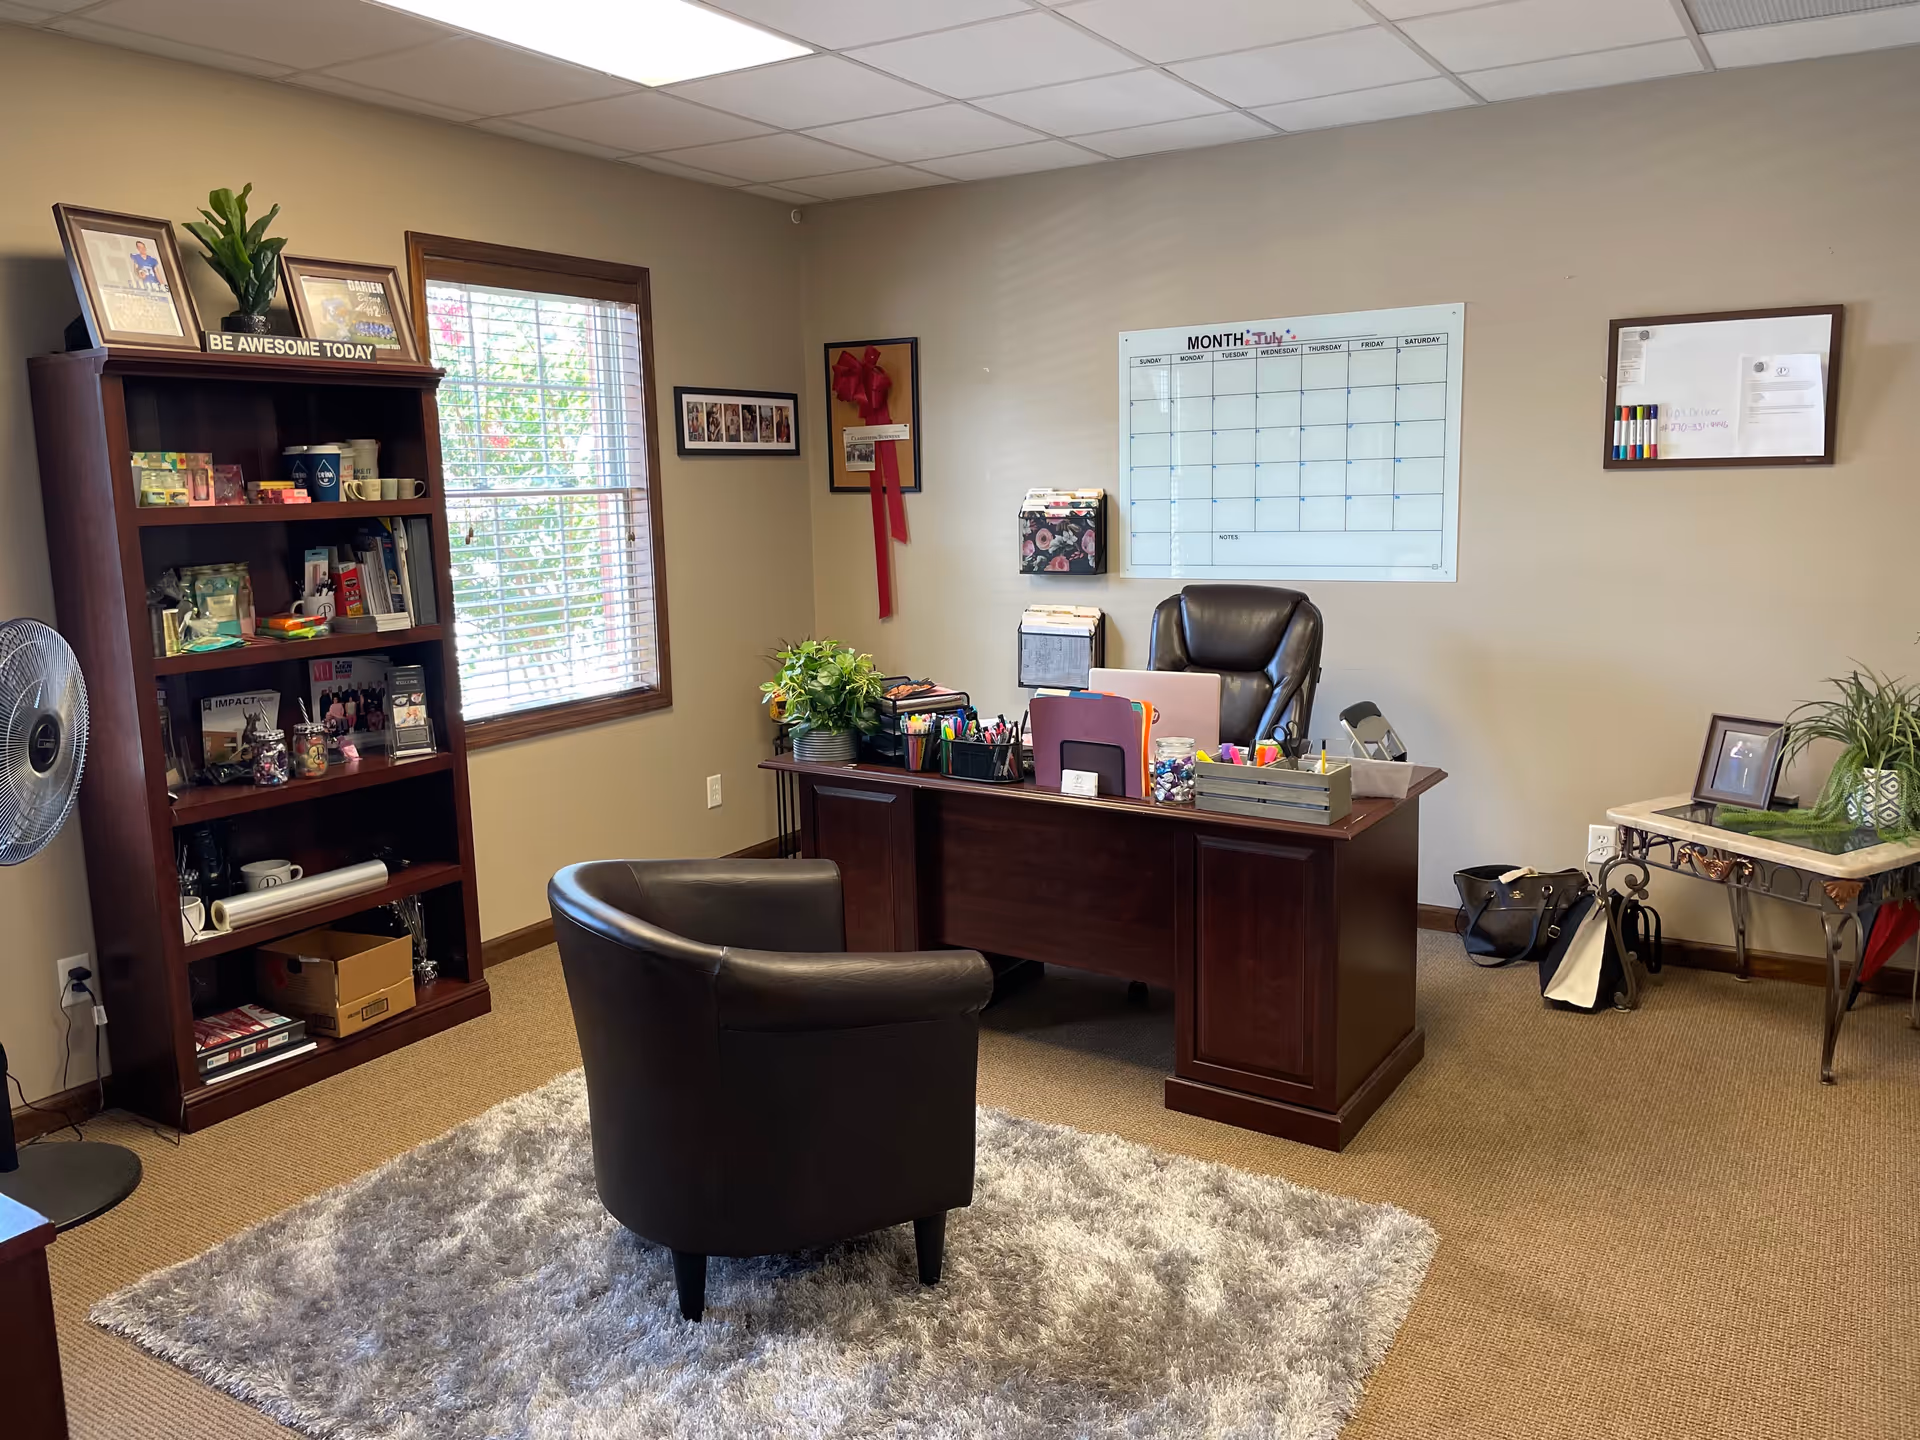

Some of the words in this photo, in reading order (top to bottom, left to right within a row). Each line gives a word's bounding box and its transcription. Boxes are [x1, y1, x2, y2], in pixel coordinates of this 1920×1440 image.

[346, 280, 384, 294] DARIEN
[209, 334, 234, 350] BE
[237, 336, 321, 357] AWESOME
[323, 342, 373, 360] TODAY
[1187, 332, 1244, 350] MONTH
[1221, 351, 1249, 359] TUESDAY
[1260, 347, 1299, 356] WEDNESDAY
[1308, 344, 1342, 352] THURSDAY
[1361, 340, 1385, 348] FRIDAY
[1404, 336, 1441, 345] SATURDAY
[1252, 331, 1284, 347] July
[215, 696, 257, 708] IMPACT
